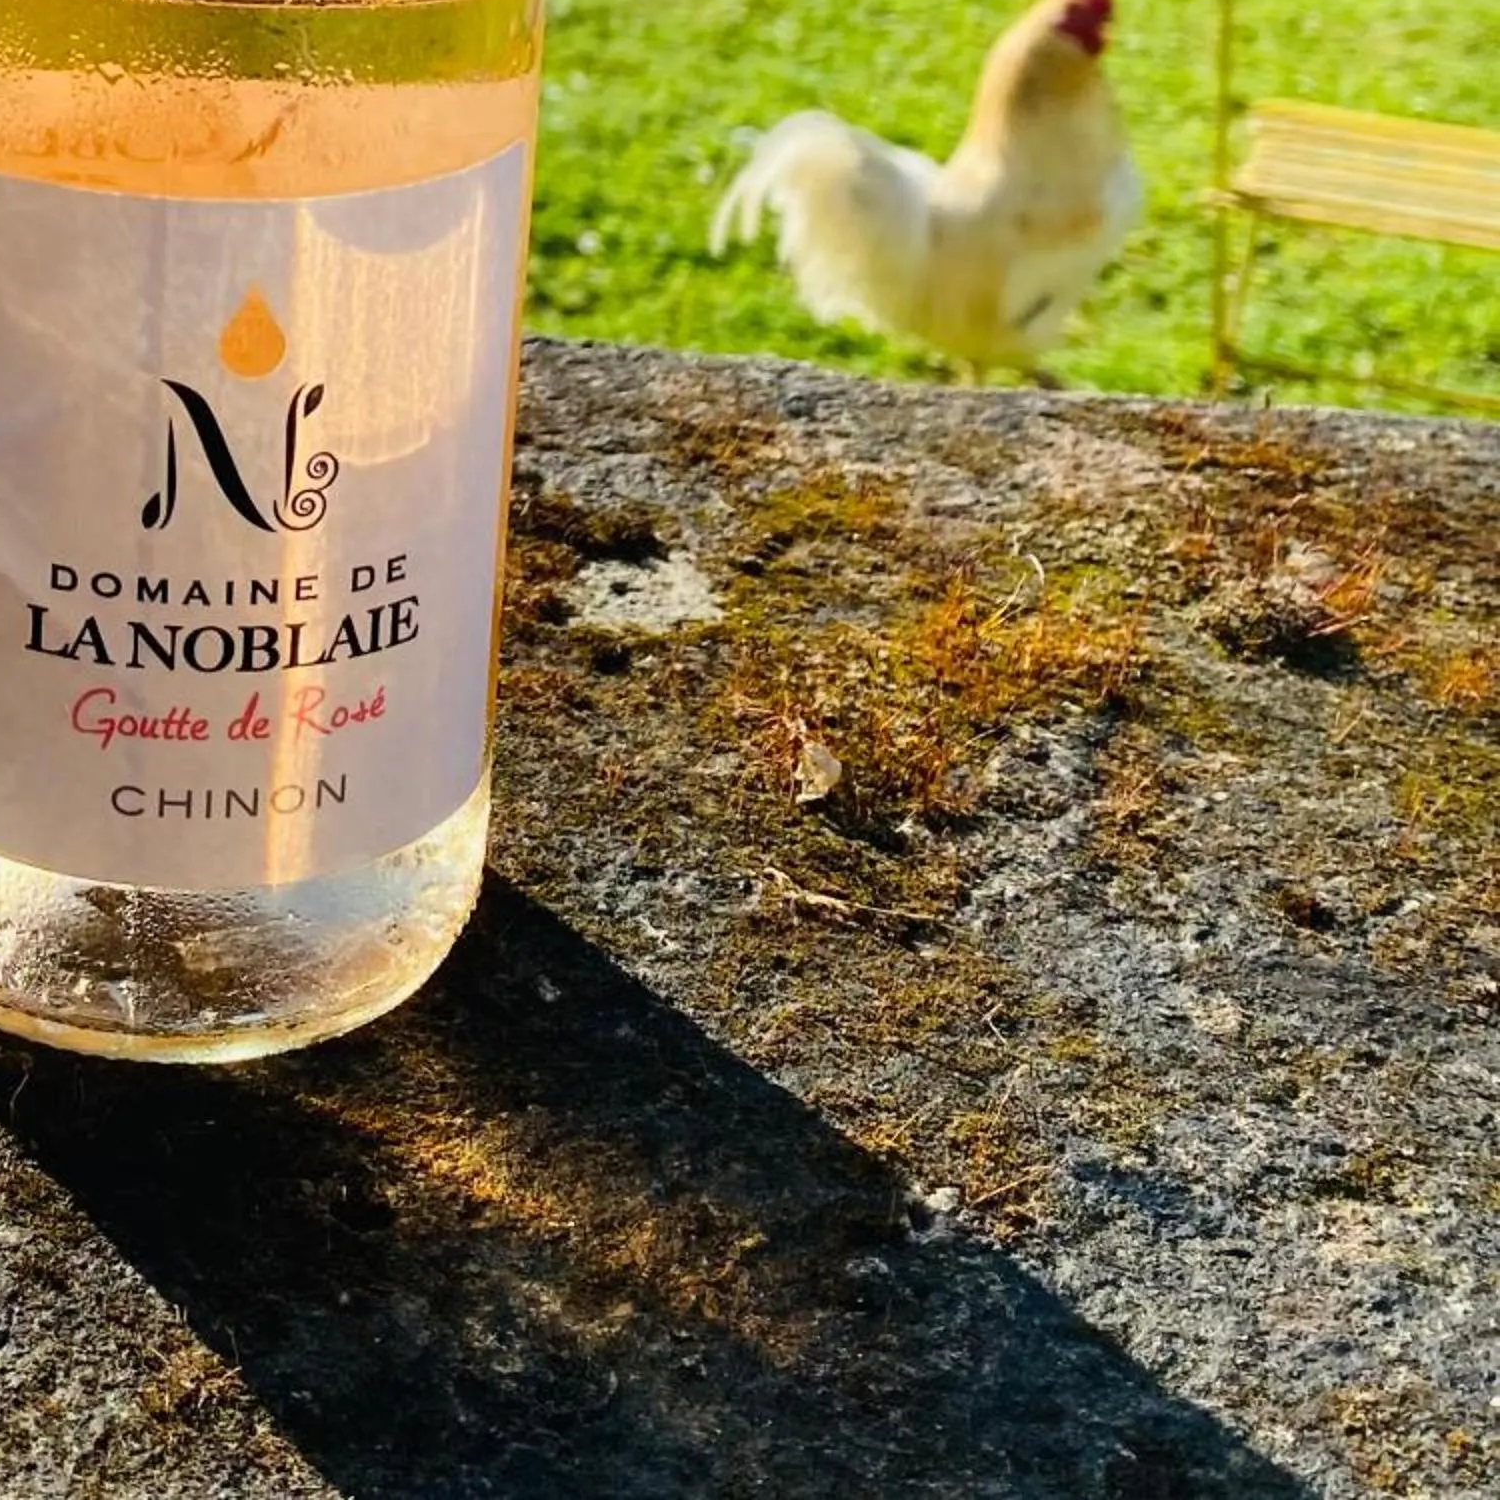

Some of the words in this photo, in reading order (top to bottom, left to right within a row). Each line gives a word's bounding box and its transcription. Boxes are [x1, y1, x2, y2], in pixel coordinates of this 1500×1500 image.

[51, 563, 319, 605] DOMAINE
[351, 553, 407, 592] DE
[24, 602, 116, 667] LA
[126, 595, 421, 674] NOBLAIE
[71, 687, 209, 749] Goutte
[227, 692, 270, 741] de
[291, 685, 387, 740] Rosé
[111, 773, 348, 820] CHINON
